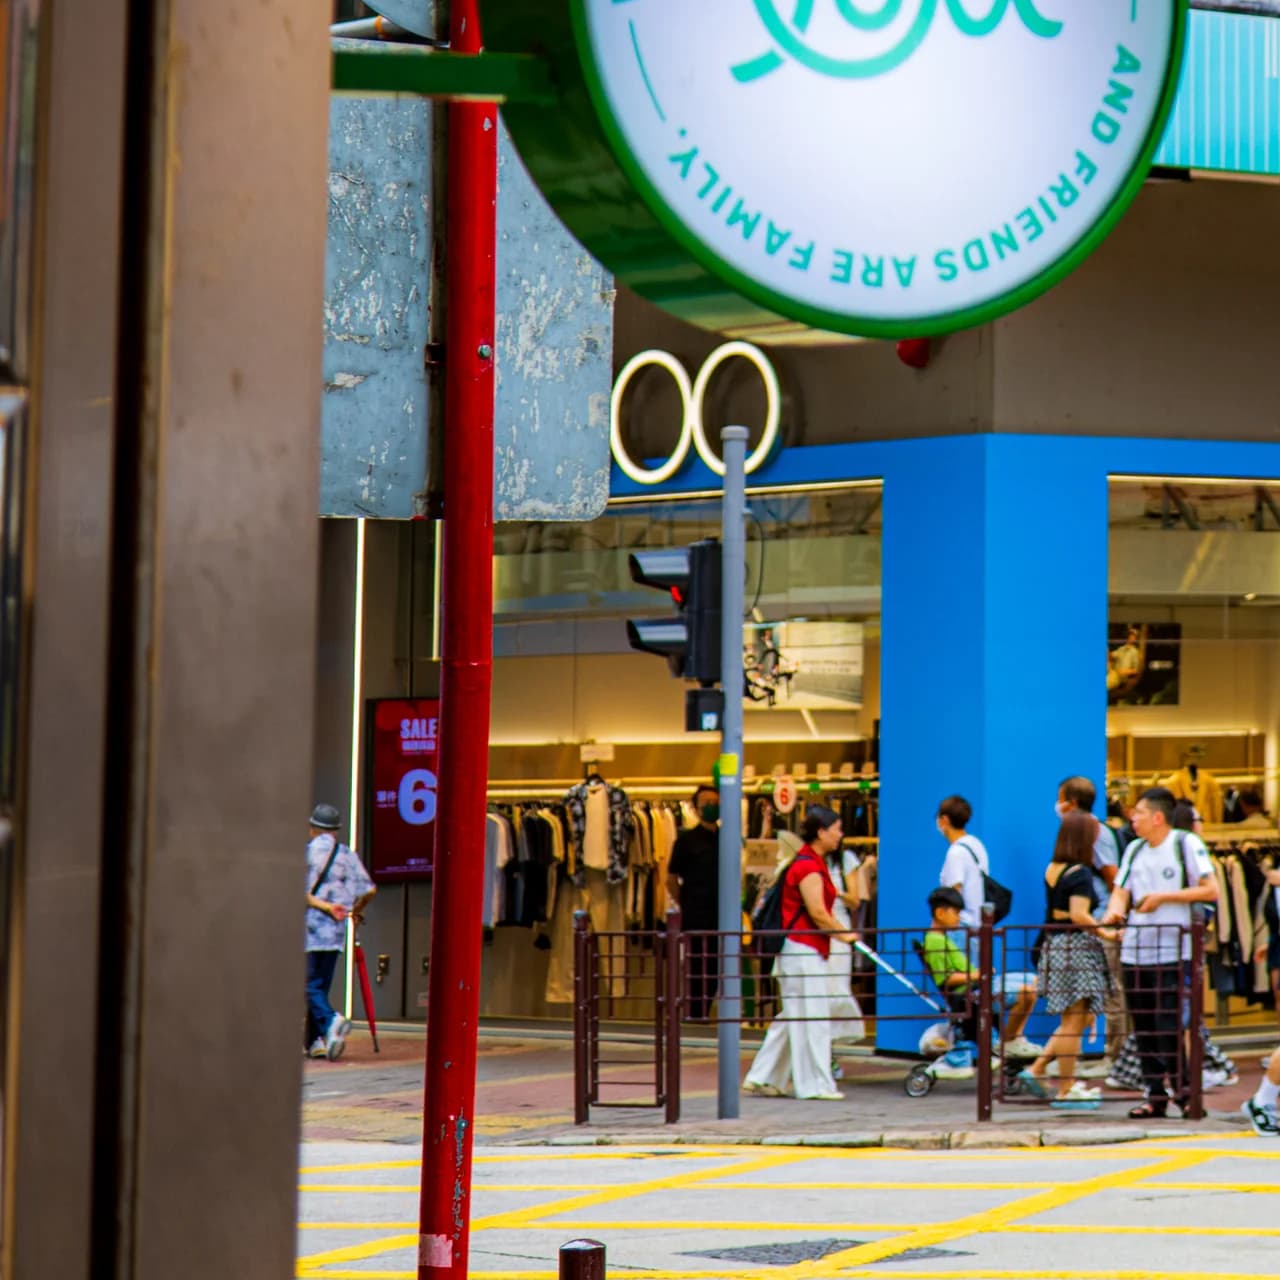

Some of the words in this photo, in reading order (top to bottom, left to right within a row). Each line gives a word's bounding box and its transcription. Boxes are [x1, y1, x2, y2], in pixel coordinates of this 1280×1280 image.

[1090, 44, 1142, 146] AND
[667, 128, 815, 272] FAMILY.
[934, 149, 1098, 281] FRIENDS
[830, 249, 918, 288] ARE
[400, 718, 438, 740] SALE
